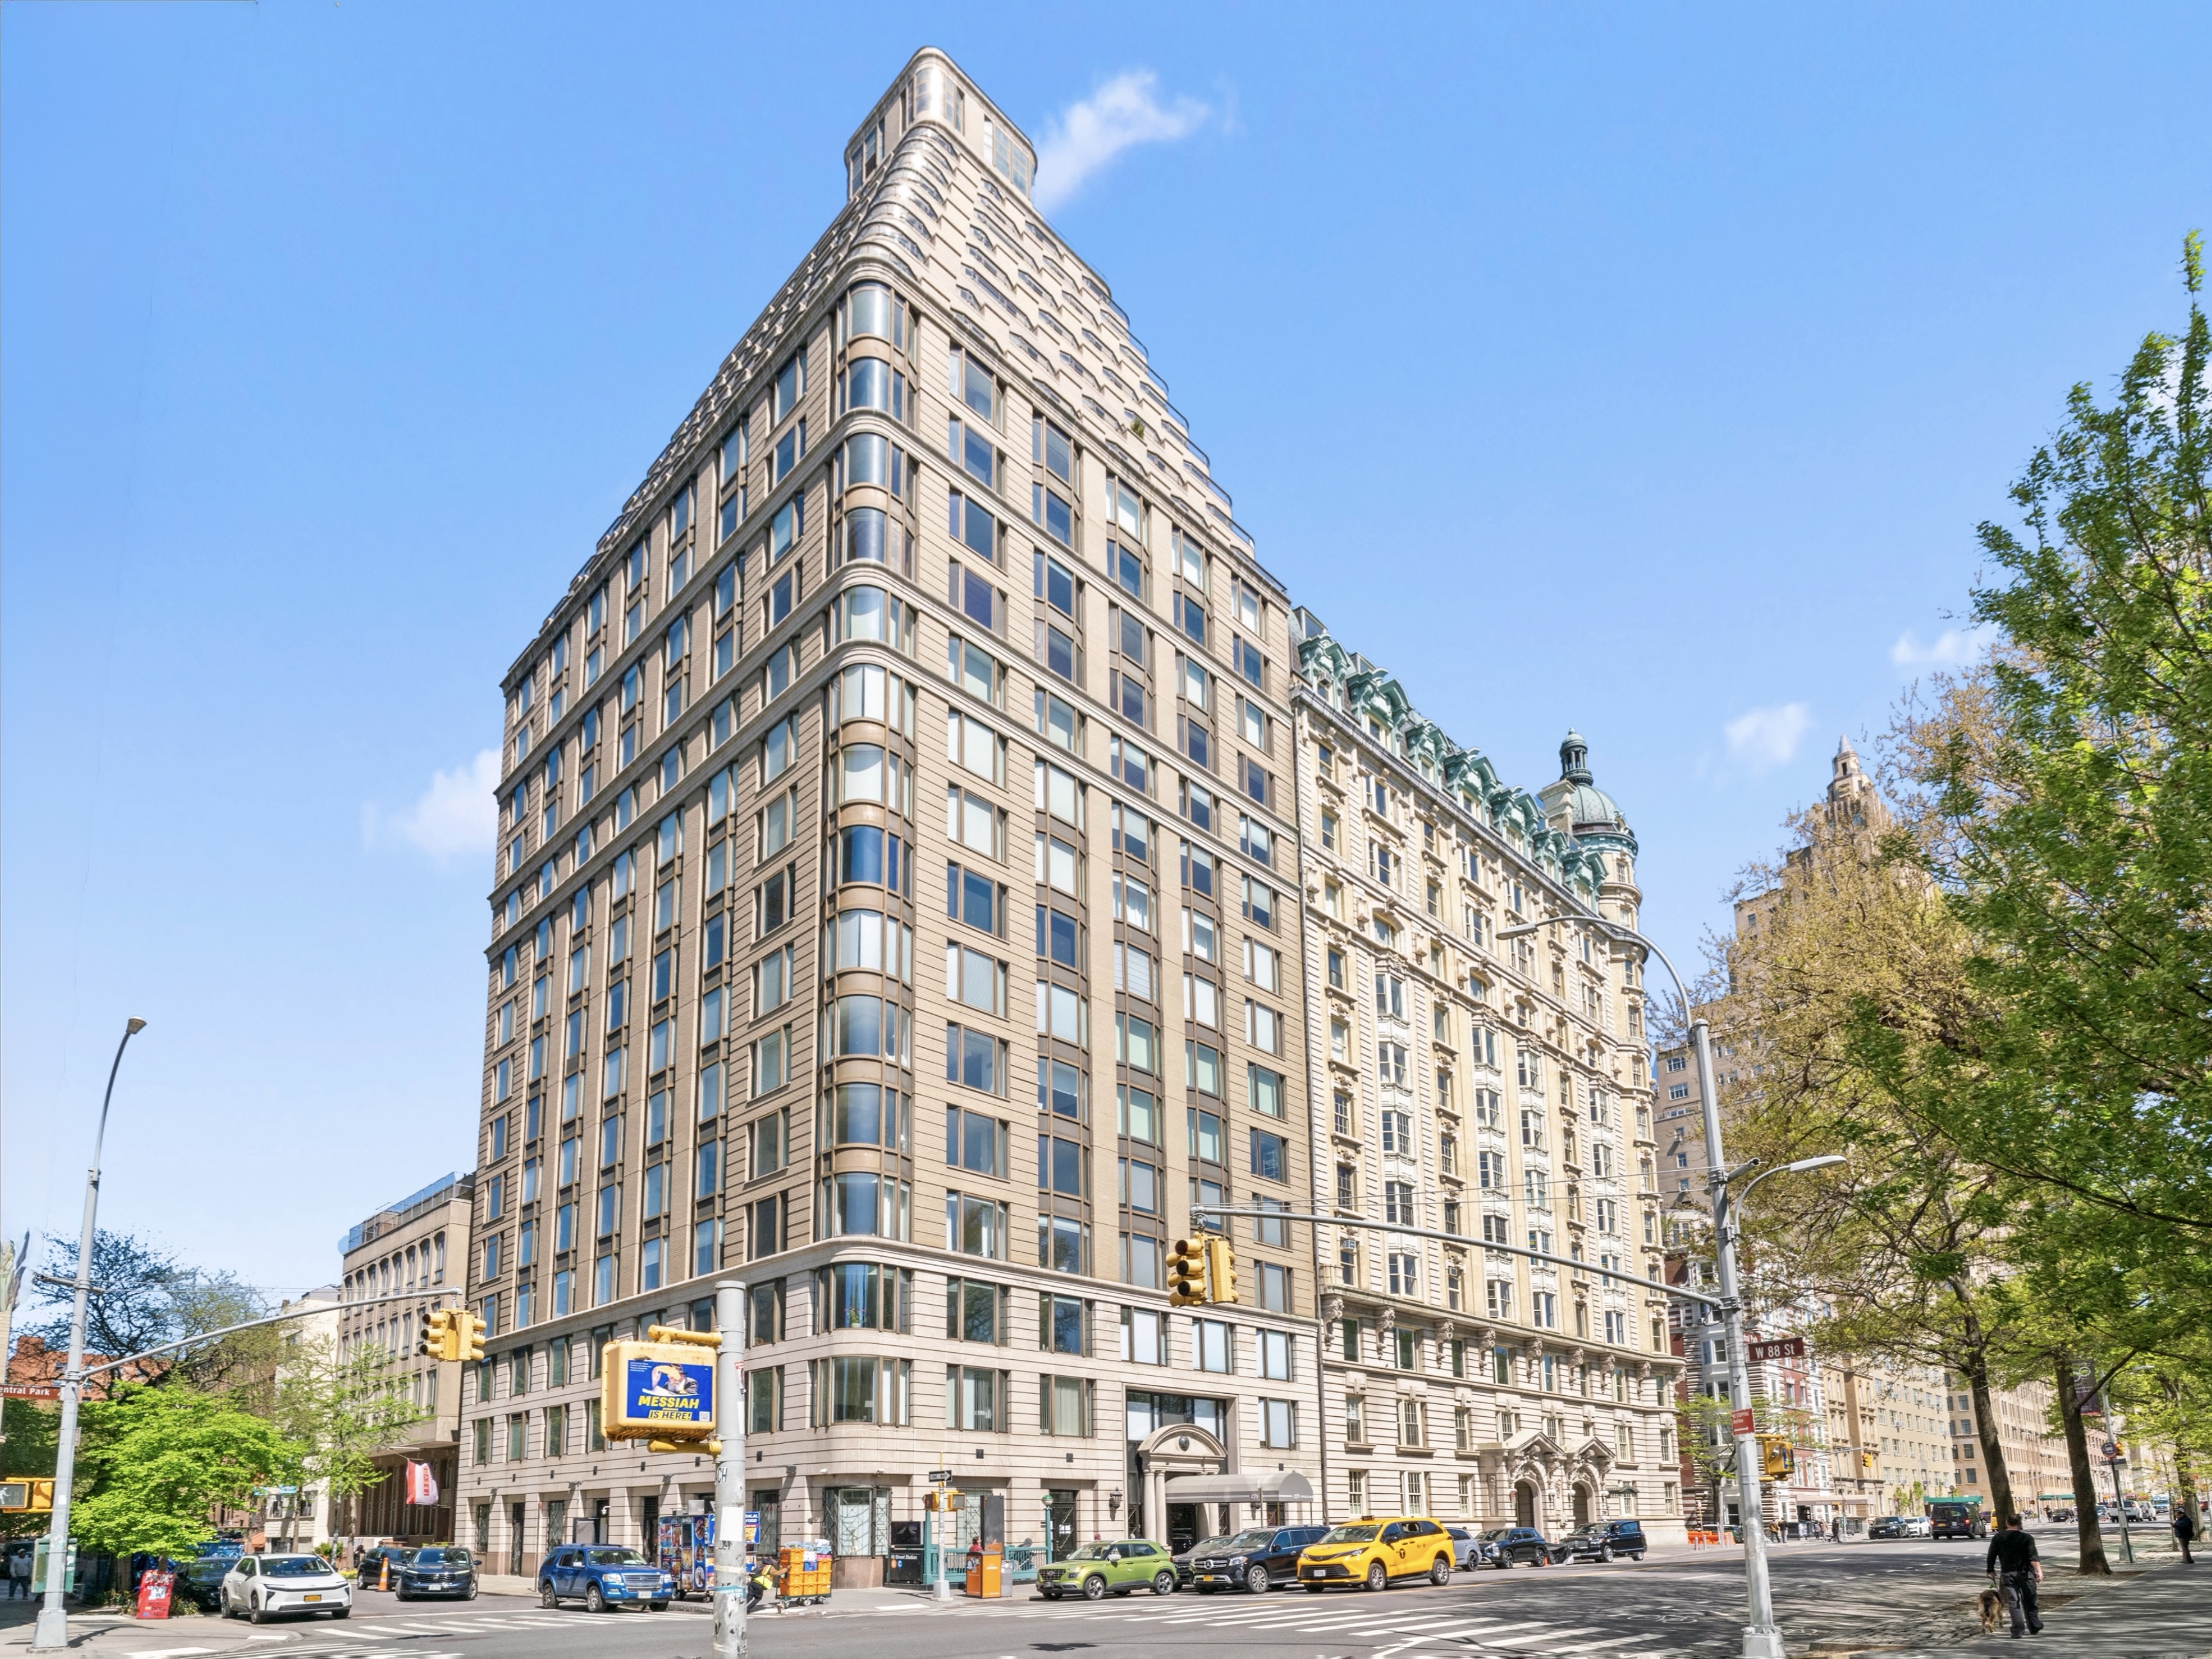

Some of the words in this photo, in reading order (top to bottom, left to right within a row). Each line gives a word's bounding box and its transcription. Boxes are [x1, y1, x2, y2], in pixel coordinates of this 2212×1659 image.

[1755, 1347, 1764, 1358] W
[1768, 1345, 1780, 1357] 88
[1784, 1343, 1794, 1355] St
[0, 1386, 26, 1394] entral
[29, 1387, 50, 1396] Park
[638, 1395, 699, 1409] MESSIAH
[662, 1412, 691, 1420] HERE!
